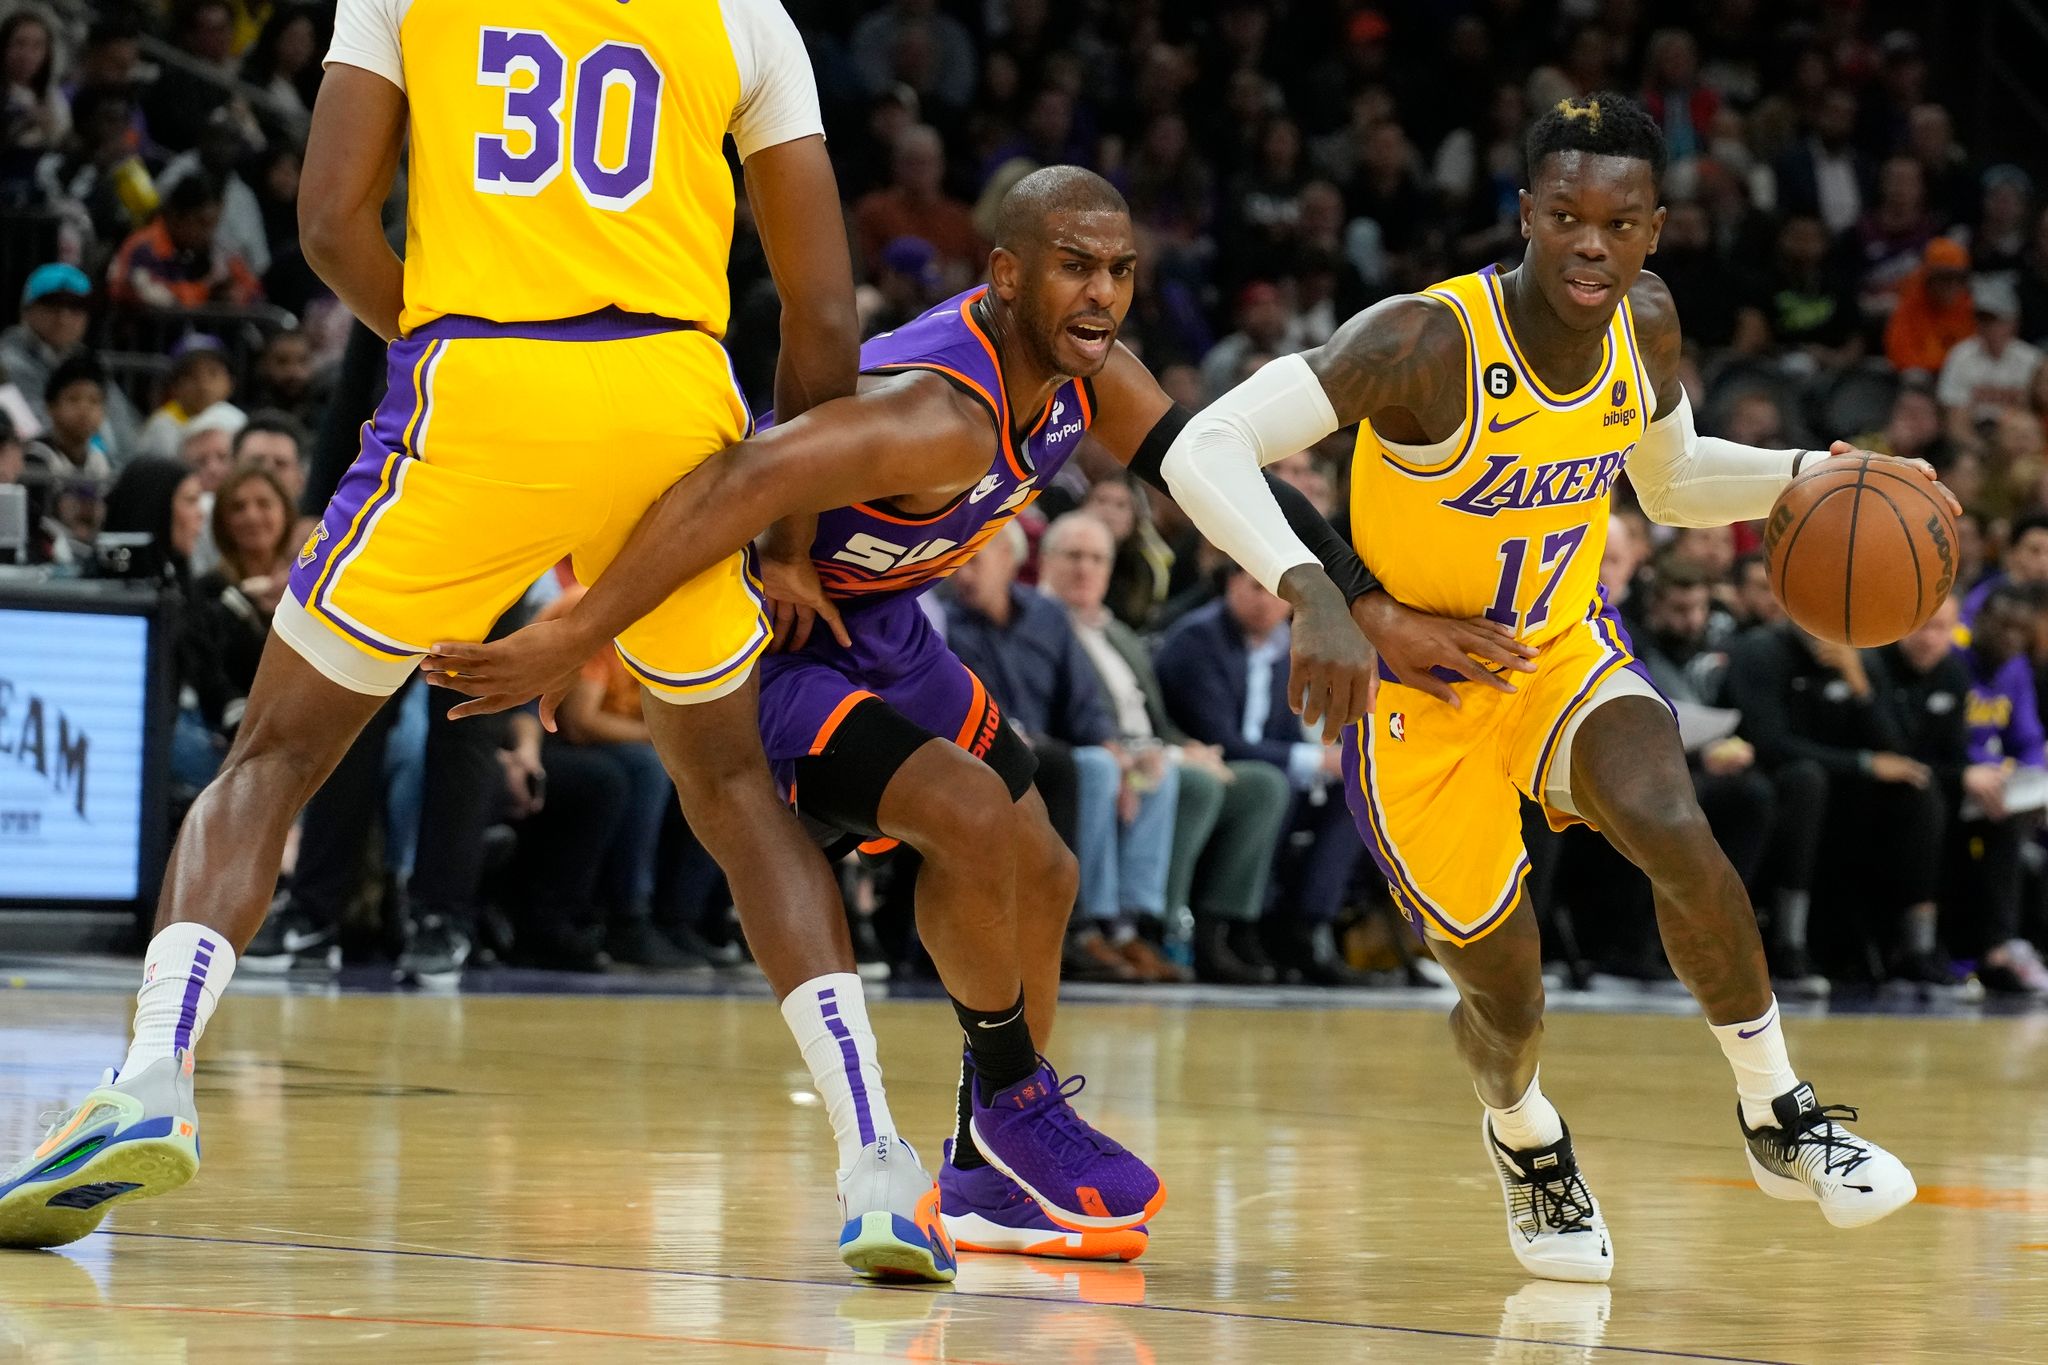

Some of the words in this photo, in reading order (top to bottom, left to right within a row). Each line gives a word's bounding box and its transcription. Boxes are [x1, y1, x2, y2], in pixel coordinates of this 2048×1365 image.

[474, 25, 665, 212] 30
[1491, 368, 1508, 395] 6
[1603, 408, 1636, 427] bibigo
[1046, 419, 1082, 446] PayPal
[1483, 522, 1591, 639] 17
